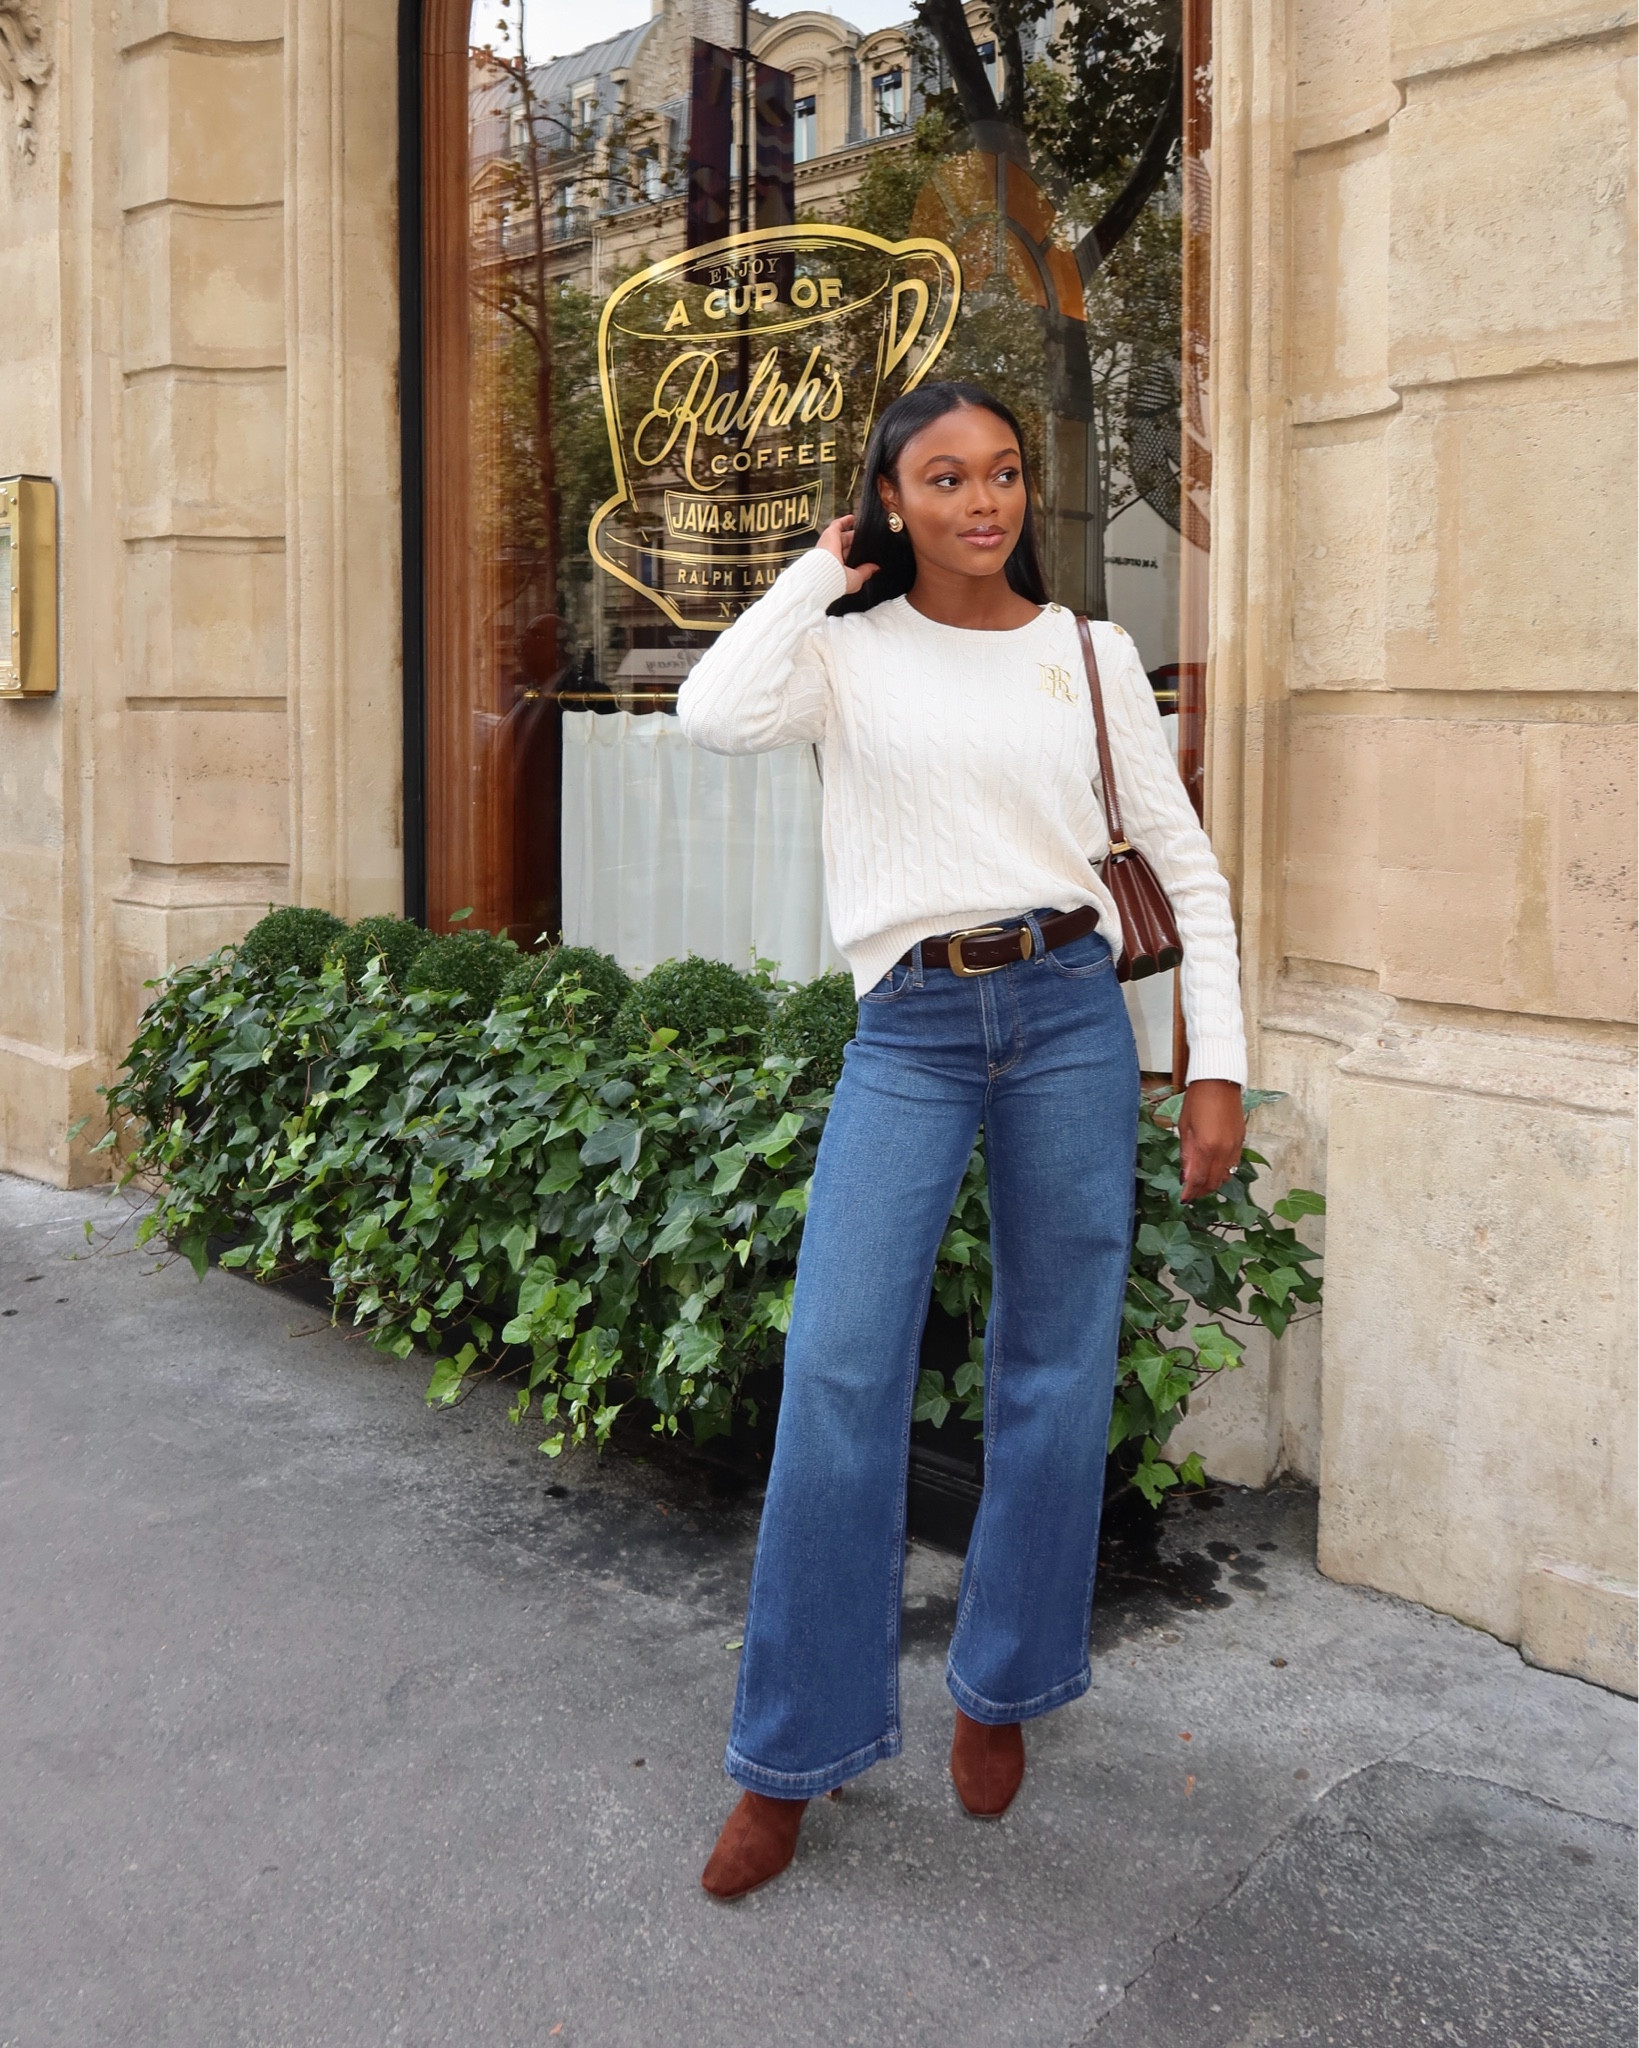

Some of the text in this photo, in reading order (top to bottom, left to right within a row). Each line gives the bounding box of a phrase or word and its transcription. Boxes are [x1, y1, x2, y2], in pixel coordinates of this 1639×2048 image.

[708, 257, 780, 286] ENJOY
[664, 277, 843, 333] A CUP OF
[633, 345, 844, 492] Ralph's
[711, 441, 837, 475] COFFEE
[677, 568, 734, 586] RALPH
